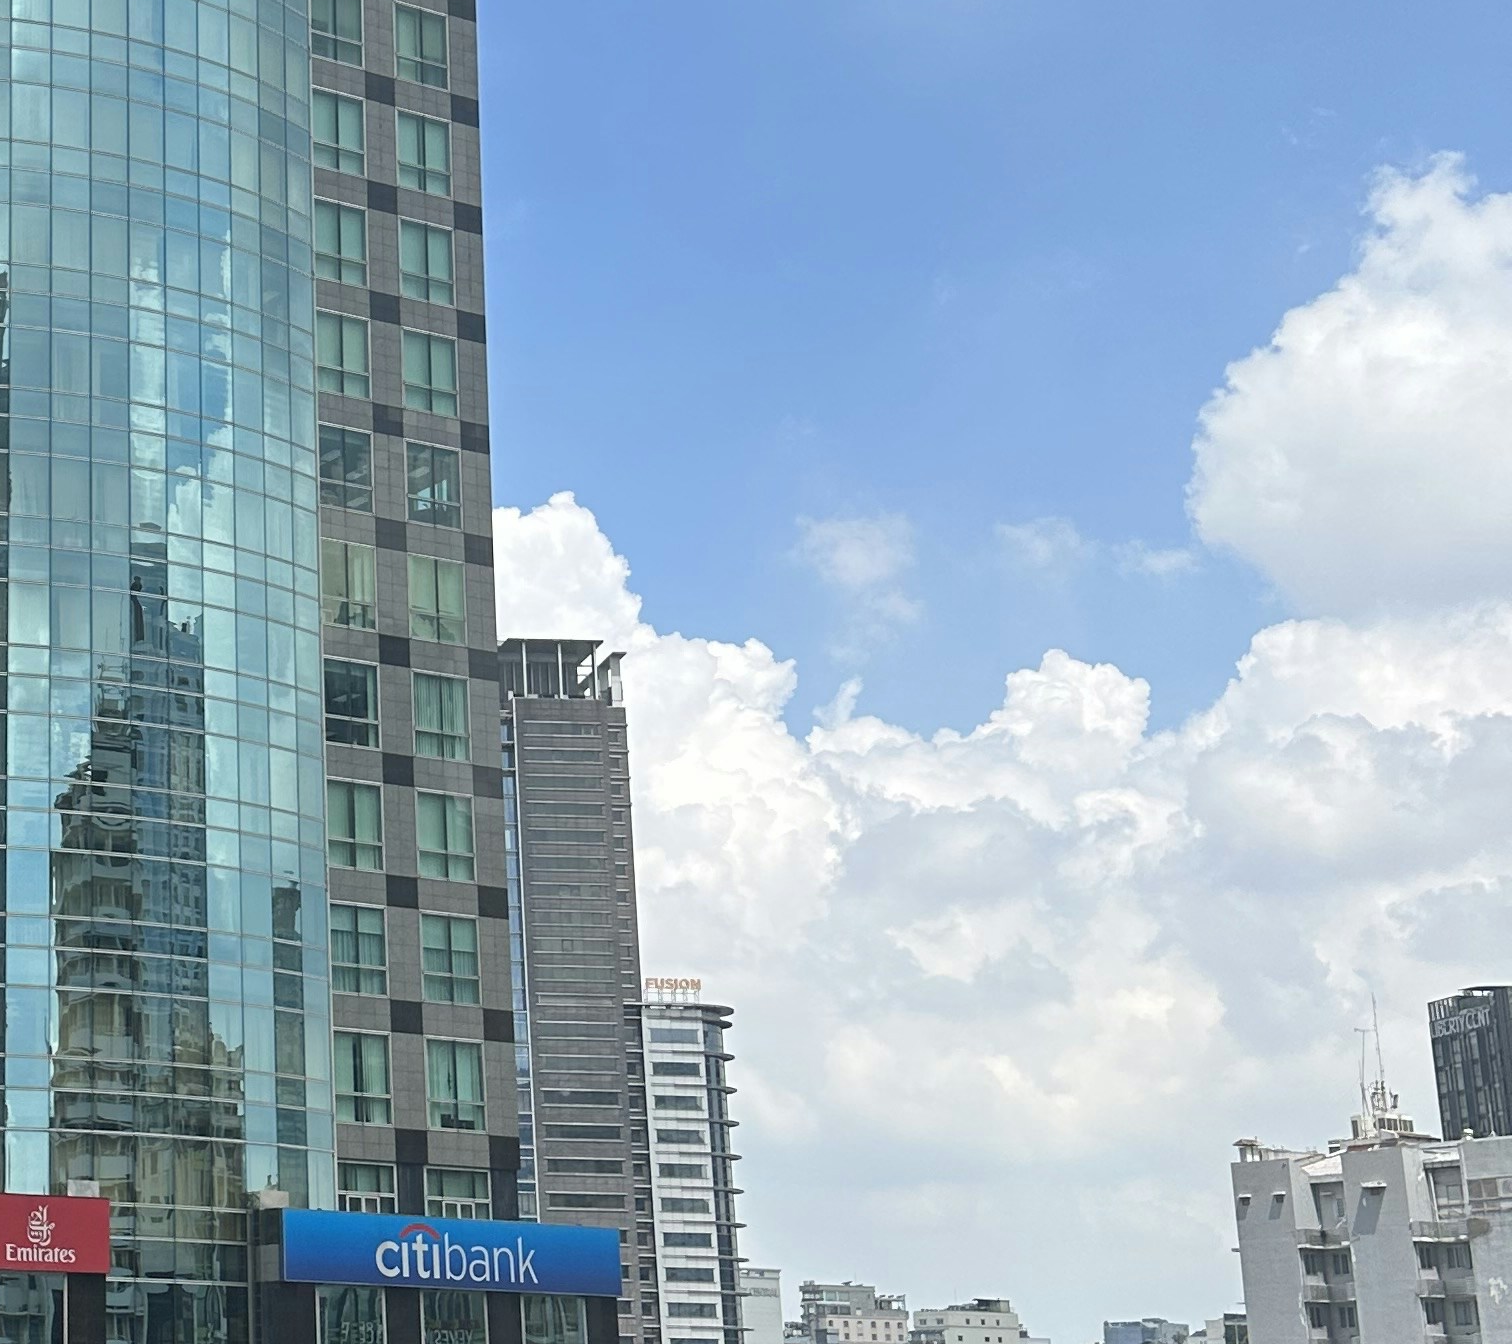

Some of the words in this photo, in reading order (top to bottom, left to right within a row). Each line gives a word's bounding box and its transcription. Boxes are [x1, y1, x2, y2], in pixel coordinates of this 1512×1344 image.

[645, 977, 701, 991] FUSION
[1431, 1016, 1465, 1038] LIBERTY
[5, 1243, 76, 1264] Emirates
[375, 1231, 539, 1284] citibank
